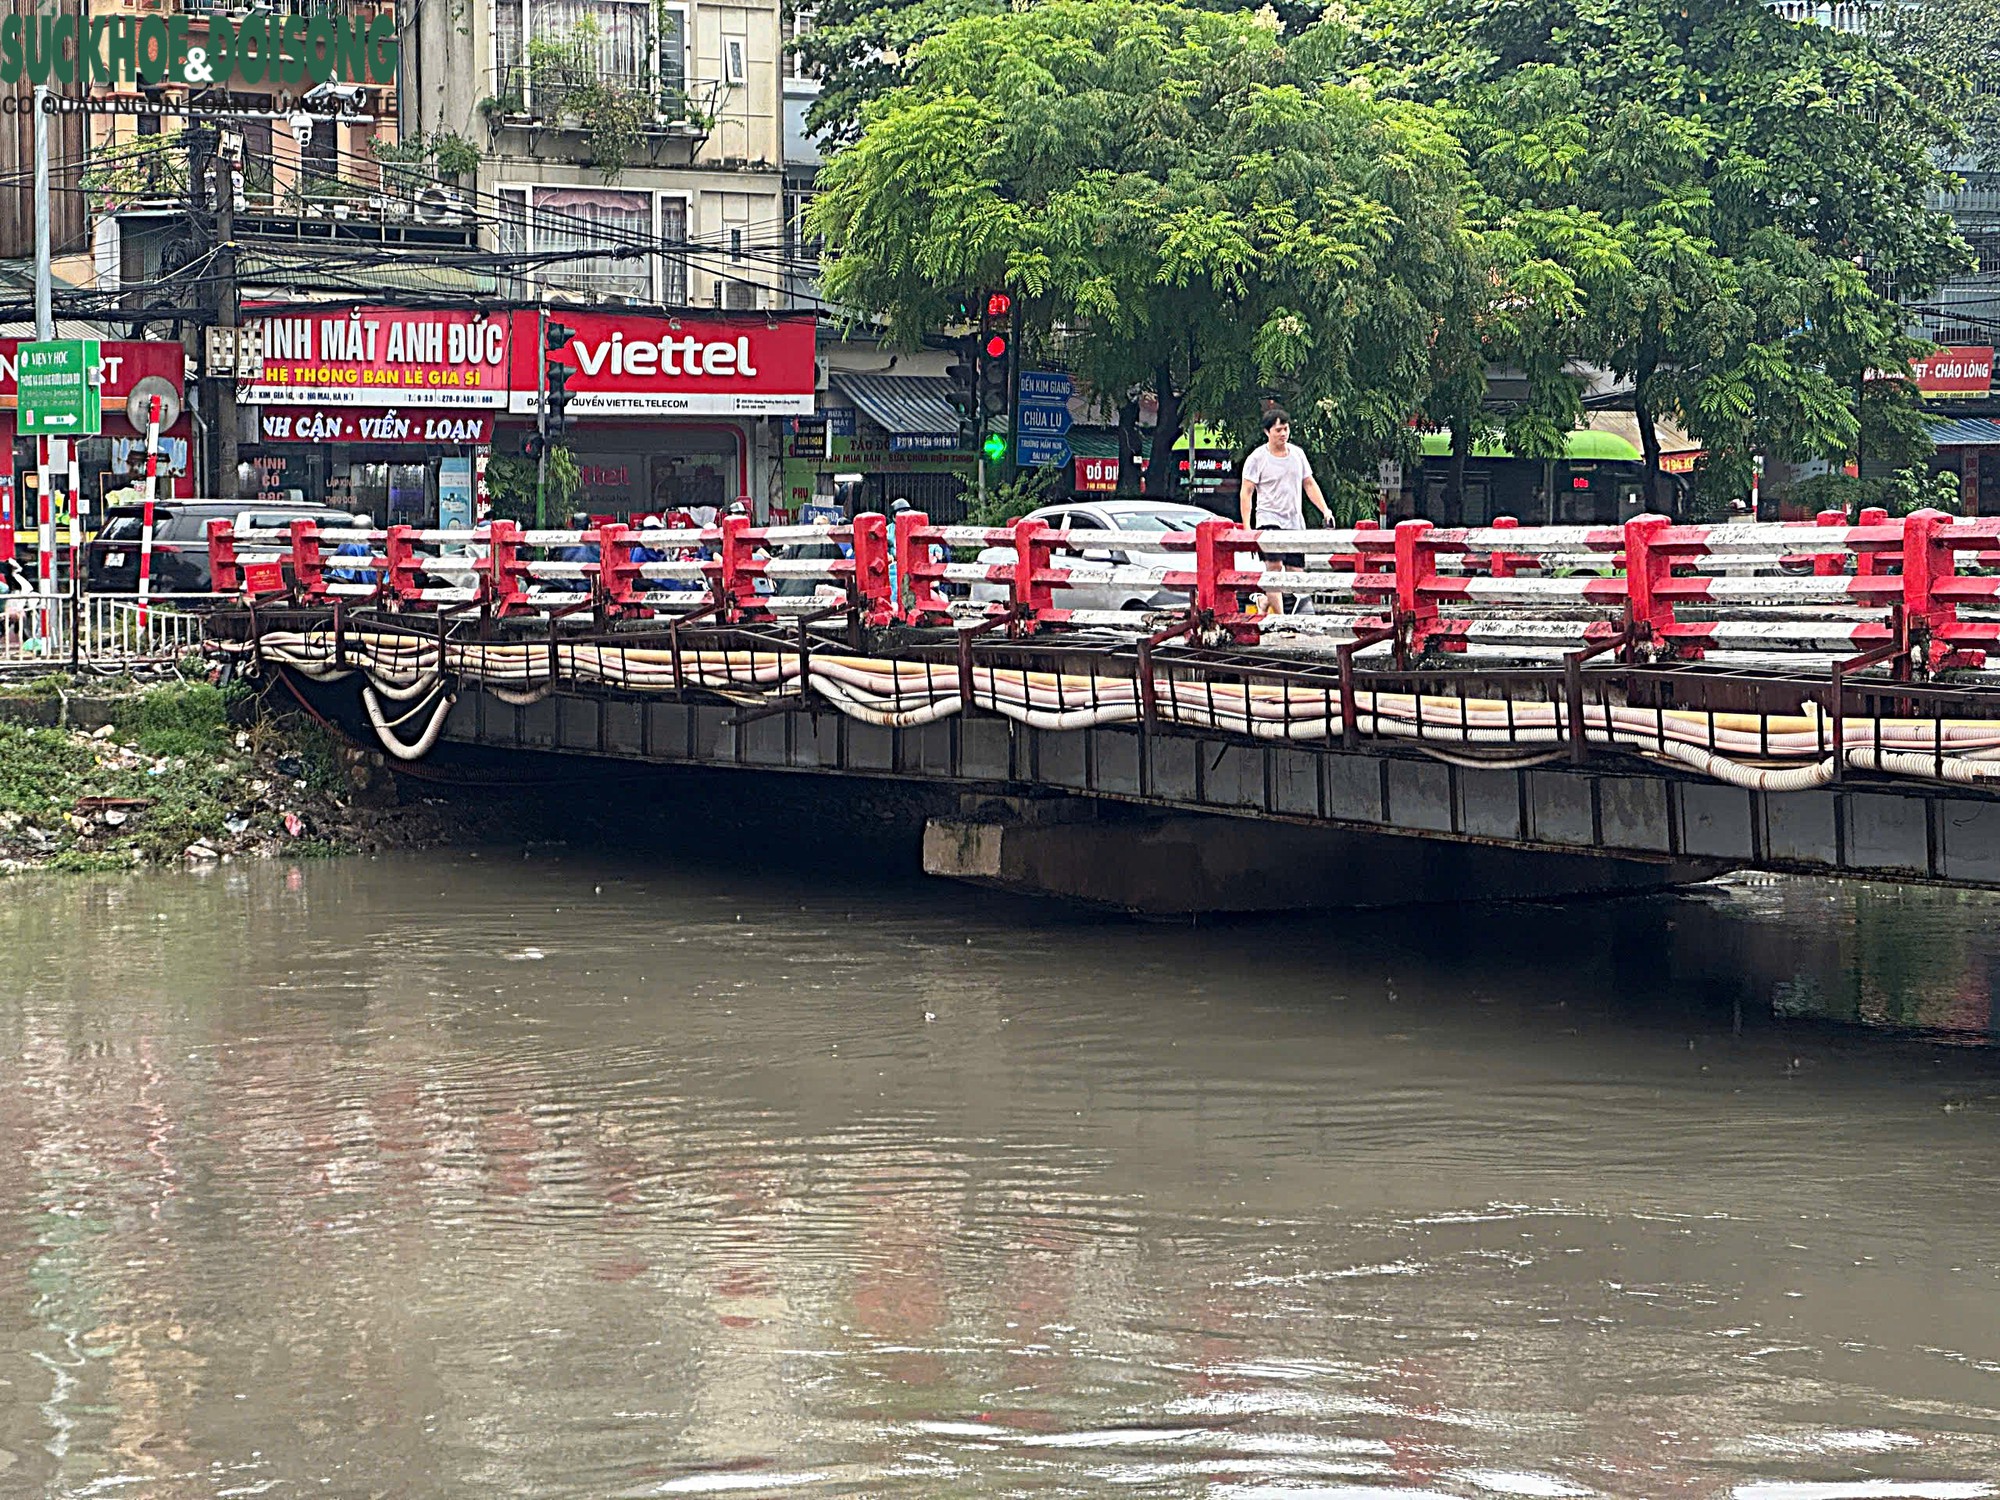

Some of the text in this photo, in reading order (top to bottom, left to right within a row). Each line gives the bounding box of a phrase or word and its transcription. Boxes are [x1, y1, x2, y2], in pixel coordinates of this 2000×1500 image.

[321, 306, 380, 361] MẮT
[387, 321, 443, 363] ANH
[448, 313, 503, 364] ĐỨC
[573, 331, 757, 377] viettel
[1934, 359, 1962, 379] CHÁO
[1963, 359, 1989, 378] LÒNG
[1035, 379, 1049, 393] KIM
[1049, 380, 1071, 395] GIANG
[606, 397, 644, 408] VIETTEL
[645, 398, 689, 409] TELECOM
[295, 412, 342, 443] CẬN
[359, 409, 410, 440] VIỄN
[424, 419, 483, 444] LOẠN
[1023, 407, 1047, 427] CHÙA
